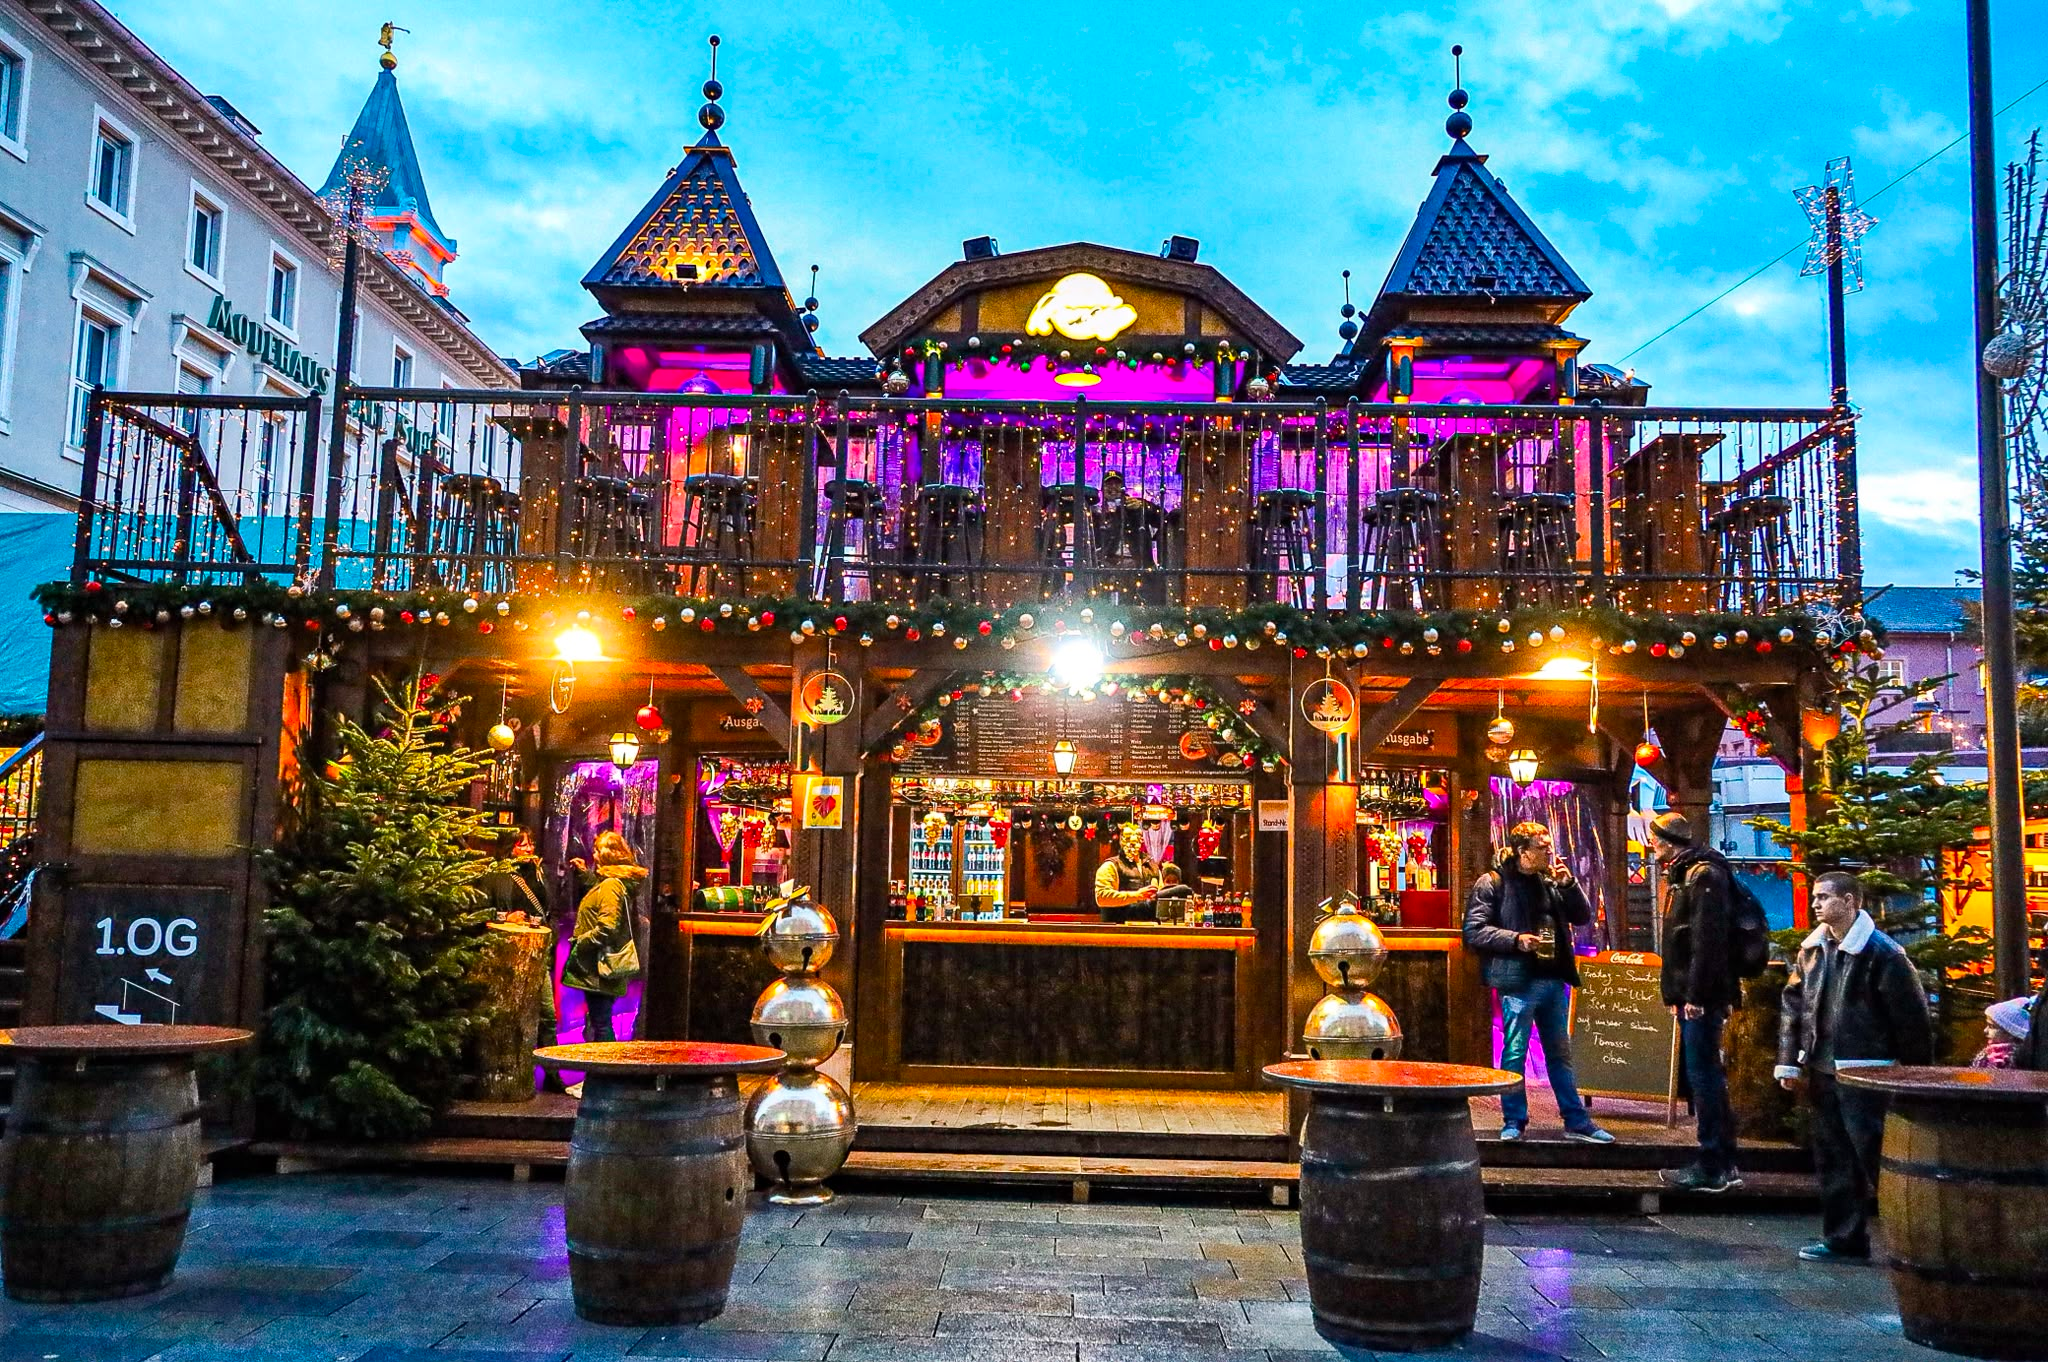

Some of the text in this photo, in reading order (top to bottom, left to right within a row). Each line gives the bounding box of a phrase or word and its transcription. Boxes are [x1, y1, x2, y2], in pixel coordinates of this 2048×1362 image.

[207, 295, 330, 395] MODEHAUS
[724, 715, 763, 730] Ausga
[96, 917, 198, 957] 1.OG
[1629, 989, 1655, 1000] Uhr
